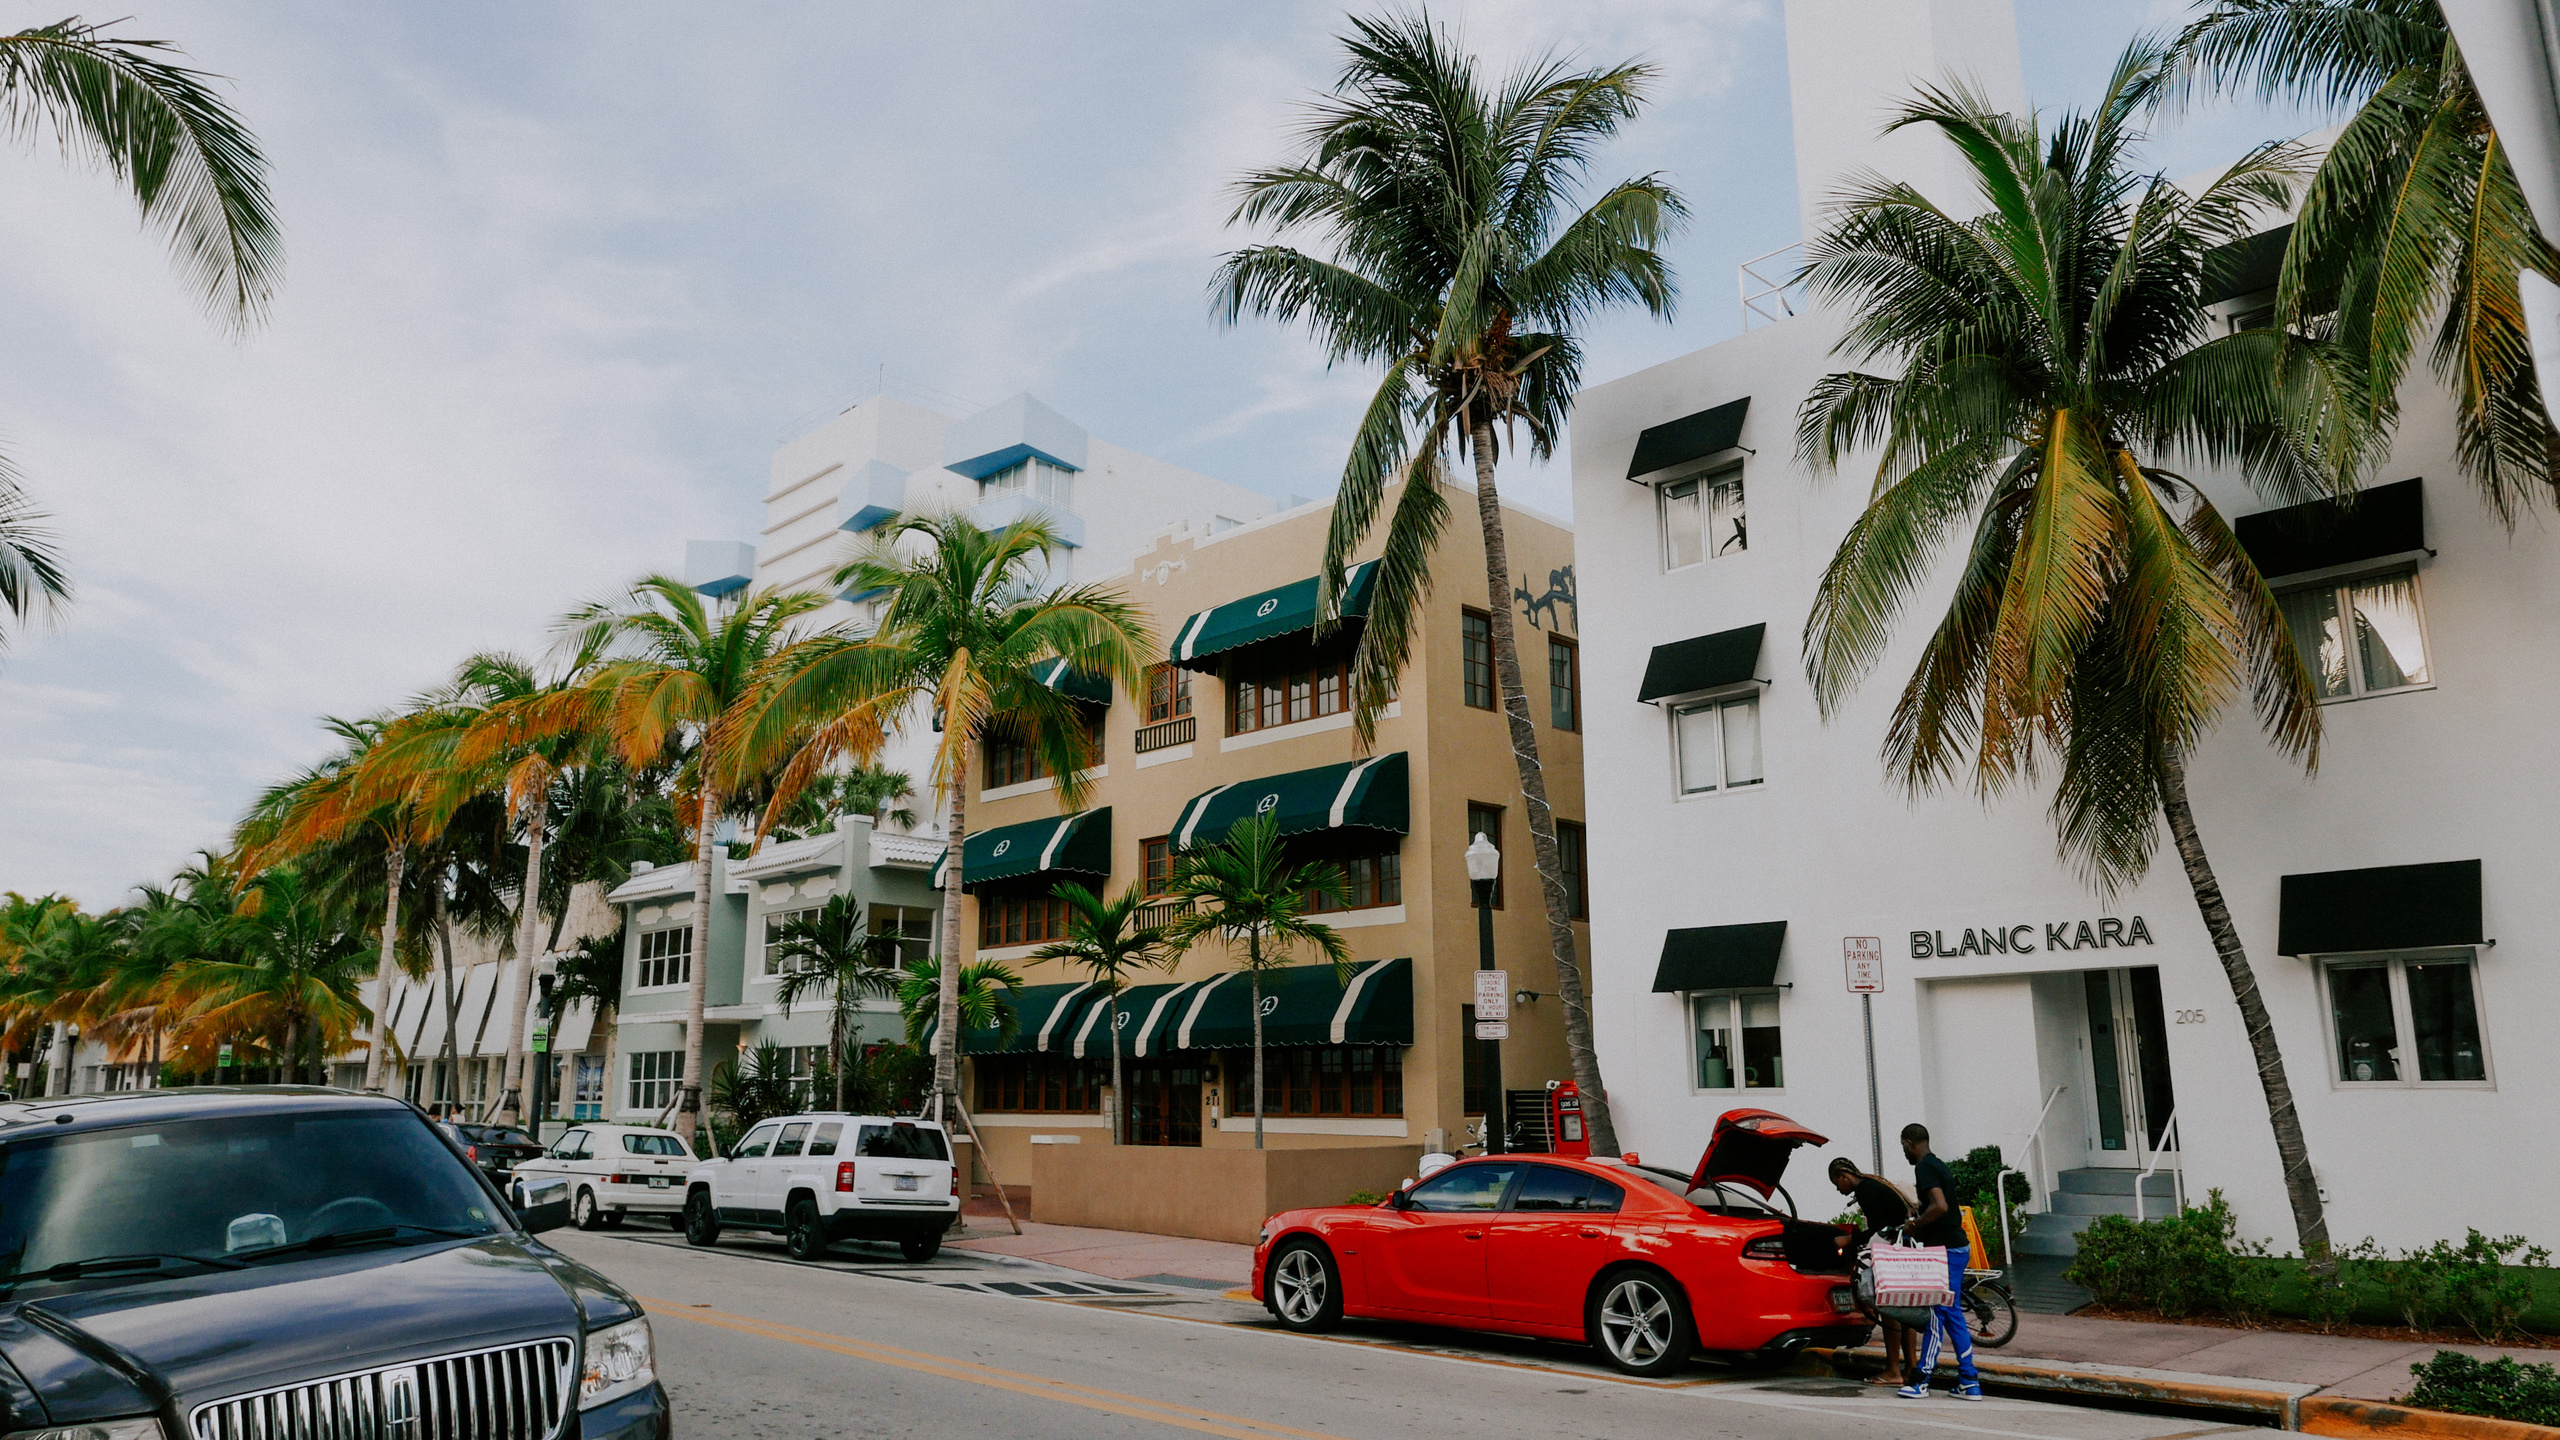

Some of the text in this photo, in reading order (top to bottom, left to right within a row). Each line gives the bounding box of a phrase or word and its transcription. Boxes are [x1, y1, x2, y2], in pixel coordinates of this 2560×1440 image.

[1910, 915, 2154, 958] BLANC KARA
[1856, 940, 1868, 949] NO
[1847, 951, 1879, 960] PARKING
[2174, 1009, 2206, 1025] 205
[1205, 1095, 1220, 1106] 211
